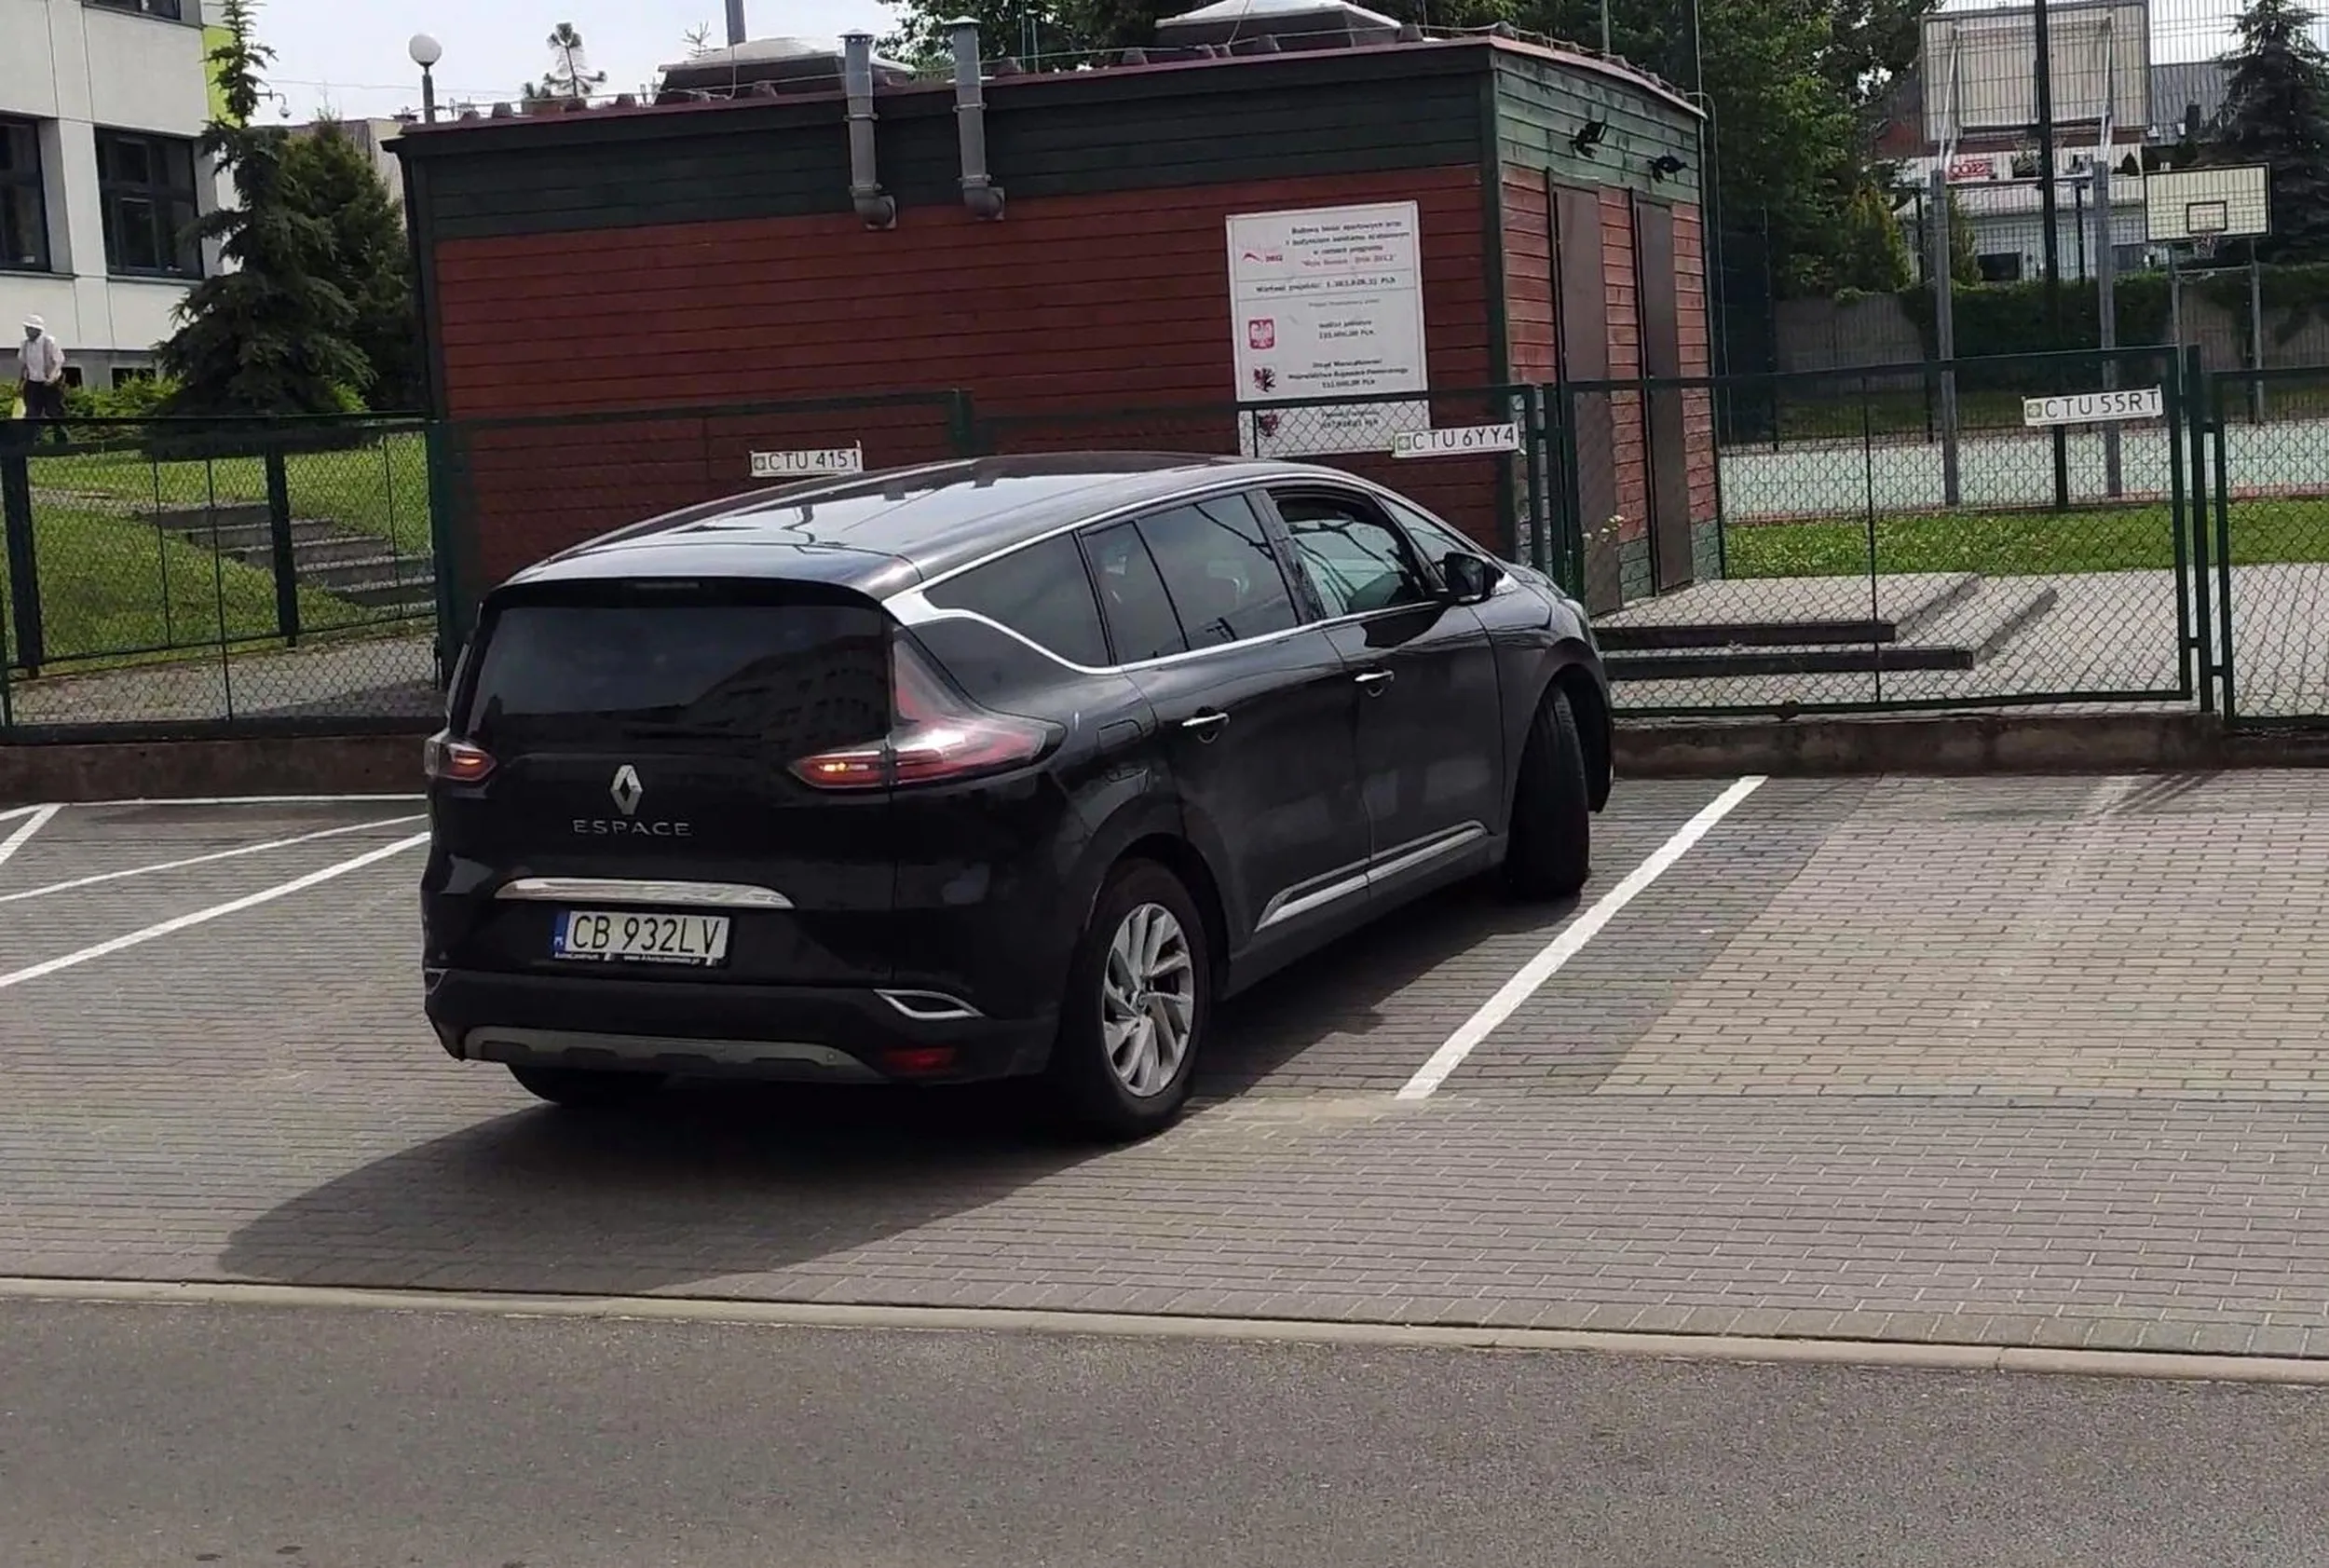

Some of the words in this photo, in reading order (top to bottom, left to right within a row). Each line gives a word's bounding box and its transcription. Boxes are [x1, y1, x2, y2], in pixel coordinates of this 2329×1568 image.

[2045, 396, 2093, 418] CTU
[2100, 390, 2159, 414] 55RT
[1412, 429, 1455, 451] CTU
[1462, 426, 1515, 447] 6YY4
[769, 452, 809, 470] CTU
[815, 450, 858, 470] 4151
[572, 819, 692, 838] ESPACE
[572, 915, 611, 949] CB
[621, 916, 720, 955] 932LV
